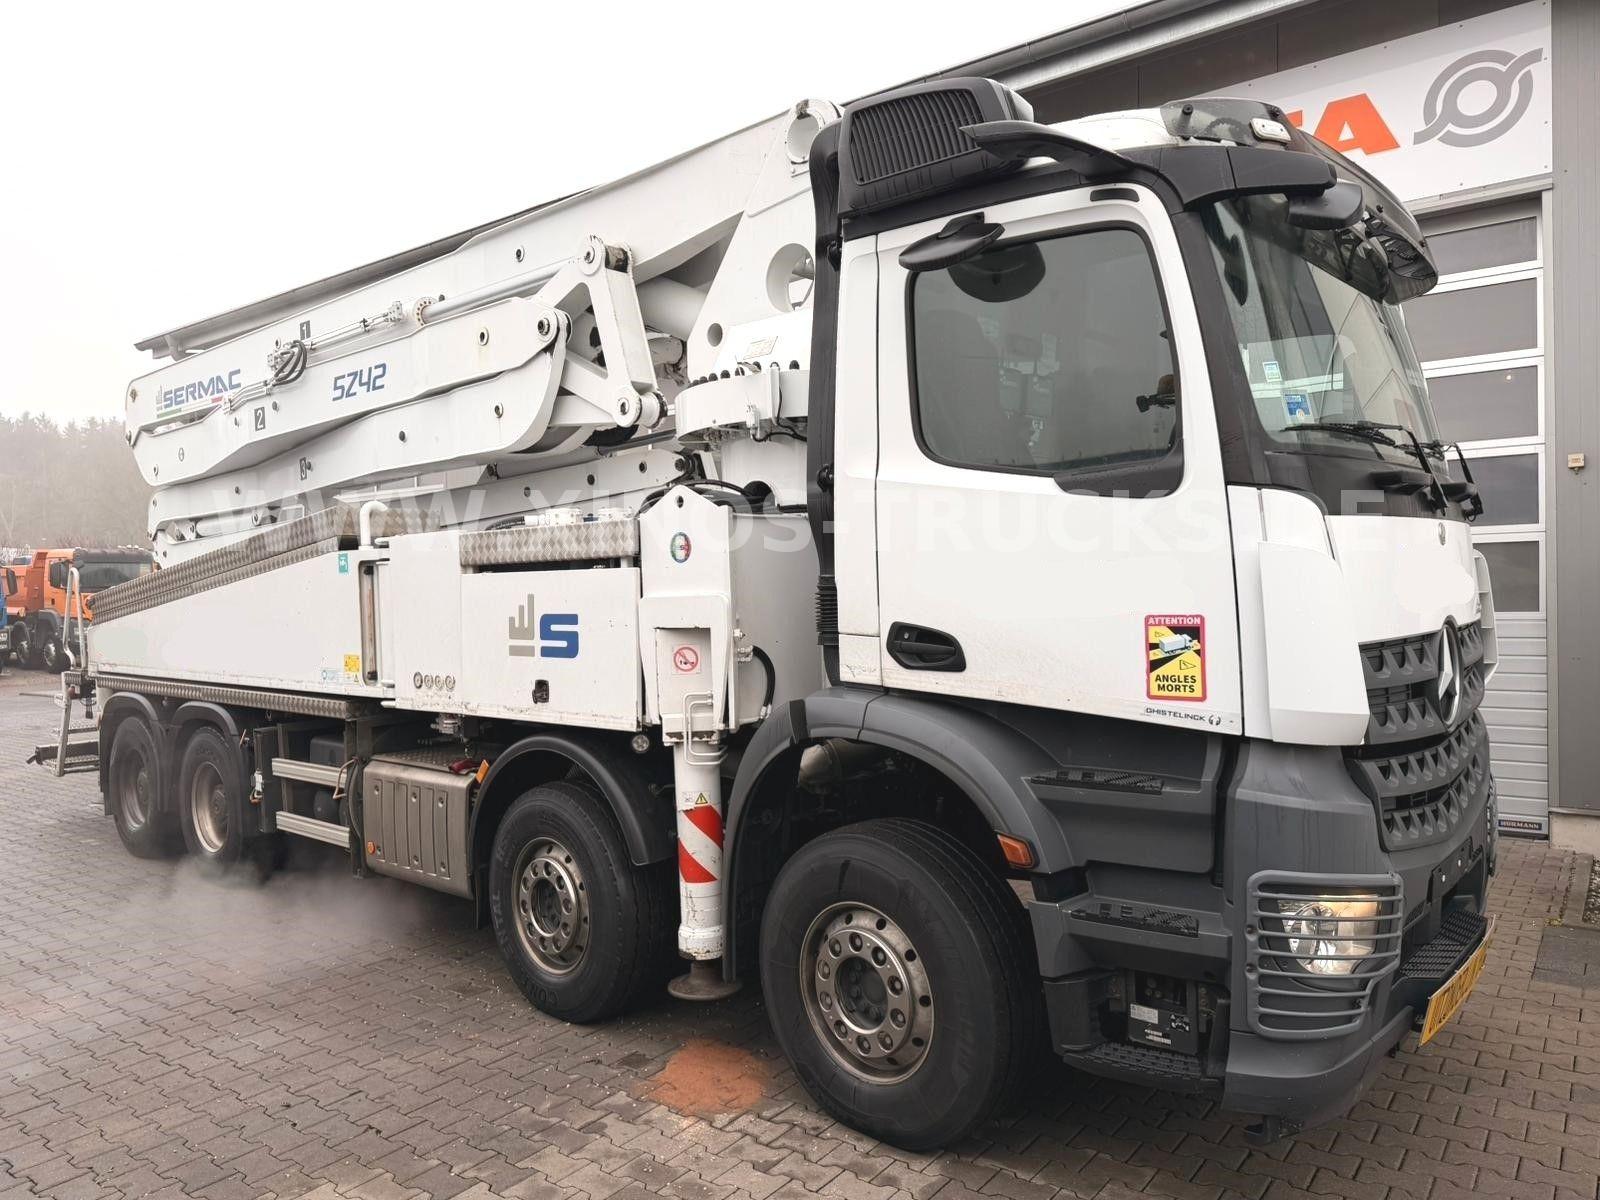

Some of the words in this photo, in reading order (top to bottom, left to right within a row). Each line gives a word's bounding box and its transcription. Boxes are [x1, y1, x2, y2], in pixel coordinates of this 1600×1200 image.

[163, 368, 242, 409] SERMAC
[256, 408, 264, 430] 2
[1148, 616, 1200, 625] ATTENTION
[1155, 674, 1197, 684] ANGLES
[1157, 683, 1195, 693] MORTS
